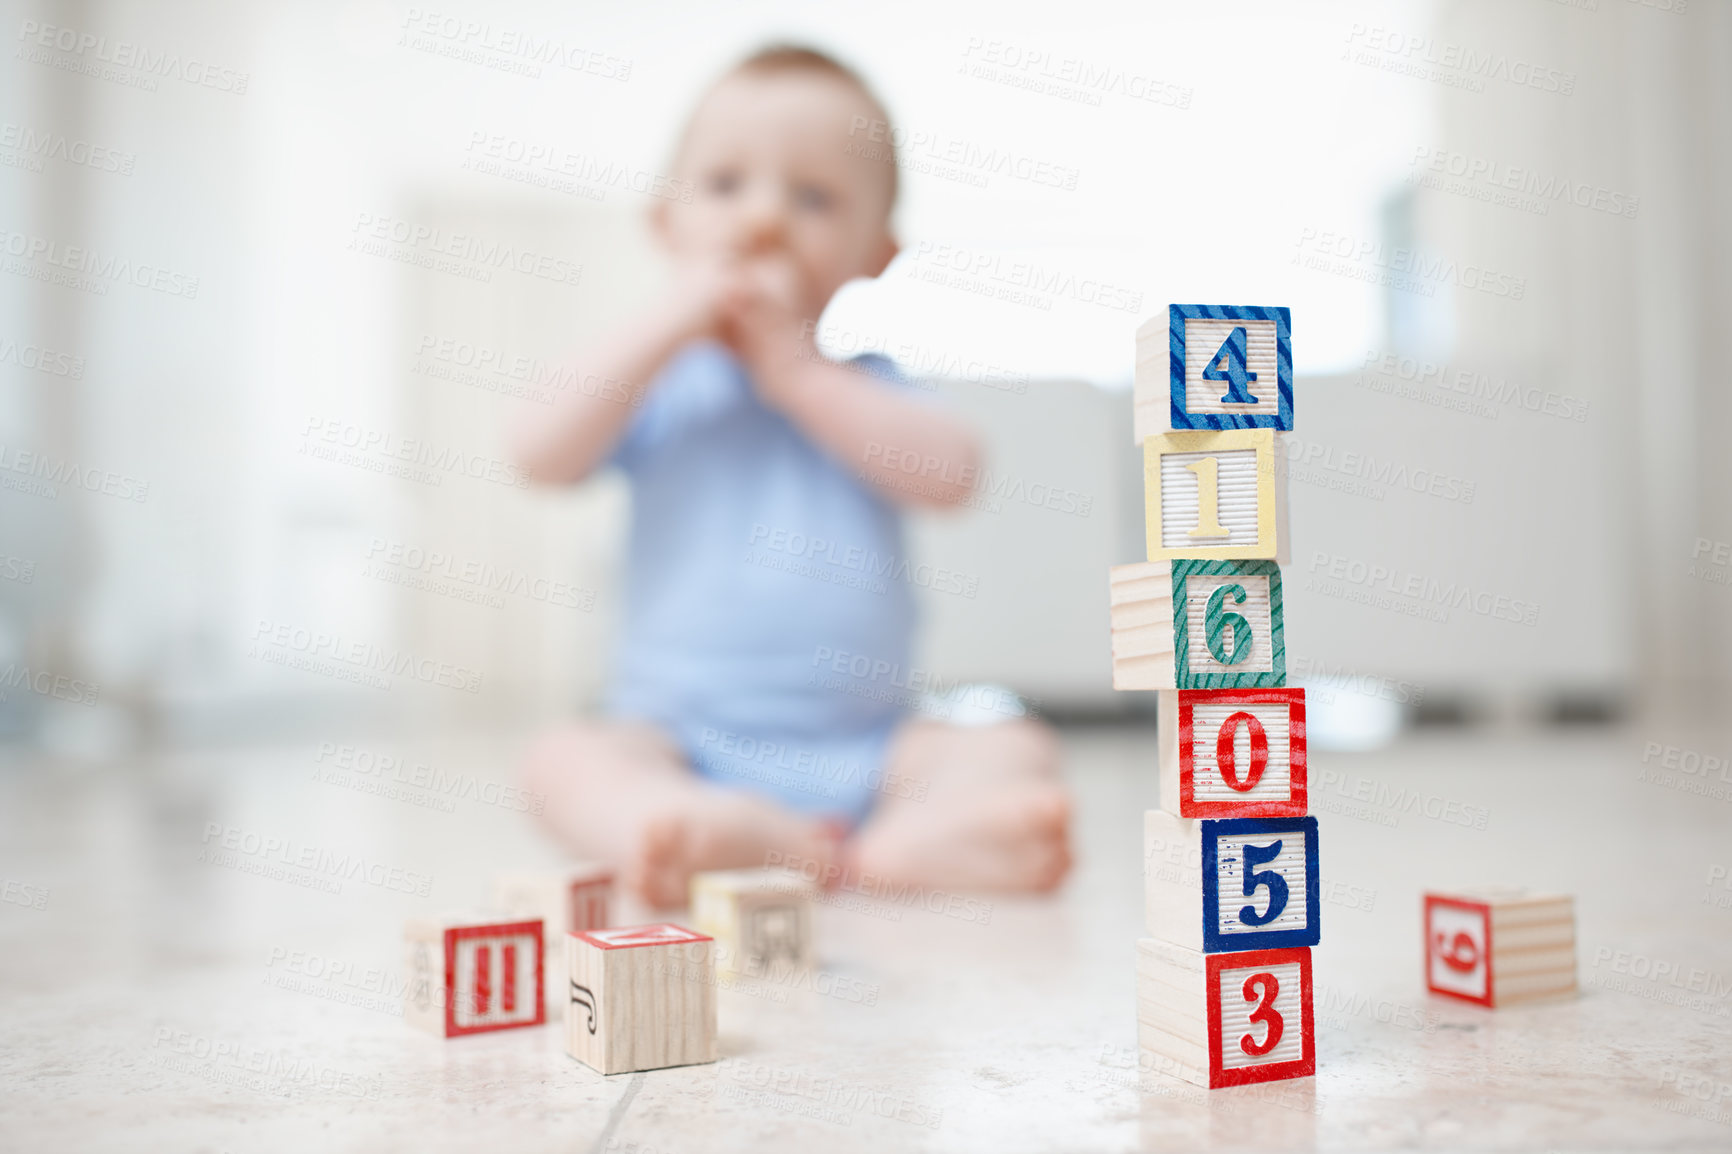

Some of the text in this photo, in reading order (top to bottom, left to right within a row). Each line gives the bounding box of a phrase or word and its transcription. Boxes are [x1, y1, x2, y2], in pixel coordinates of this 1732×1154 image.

[1202, 327, 1259, 404] 4
[1186, 456, 1230, 538] 1
[1204, 583, 1253, 666] 6
[1216, 711, 1268, 792] 0
[1238, 839, 1290, 927] 5
[1240, 972, 1285, 1057] 3
